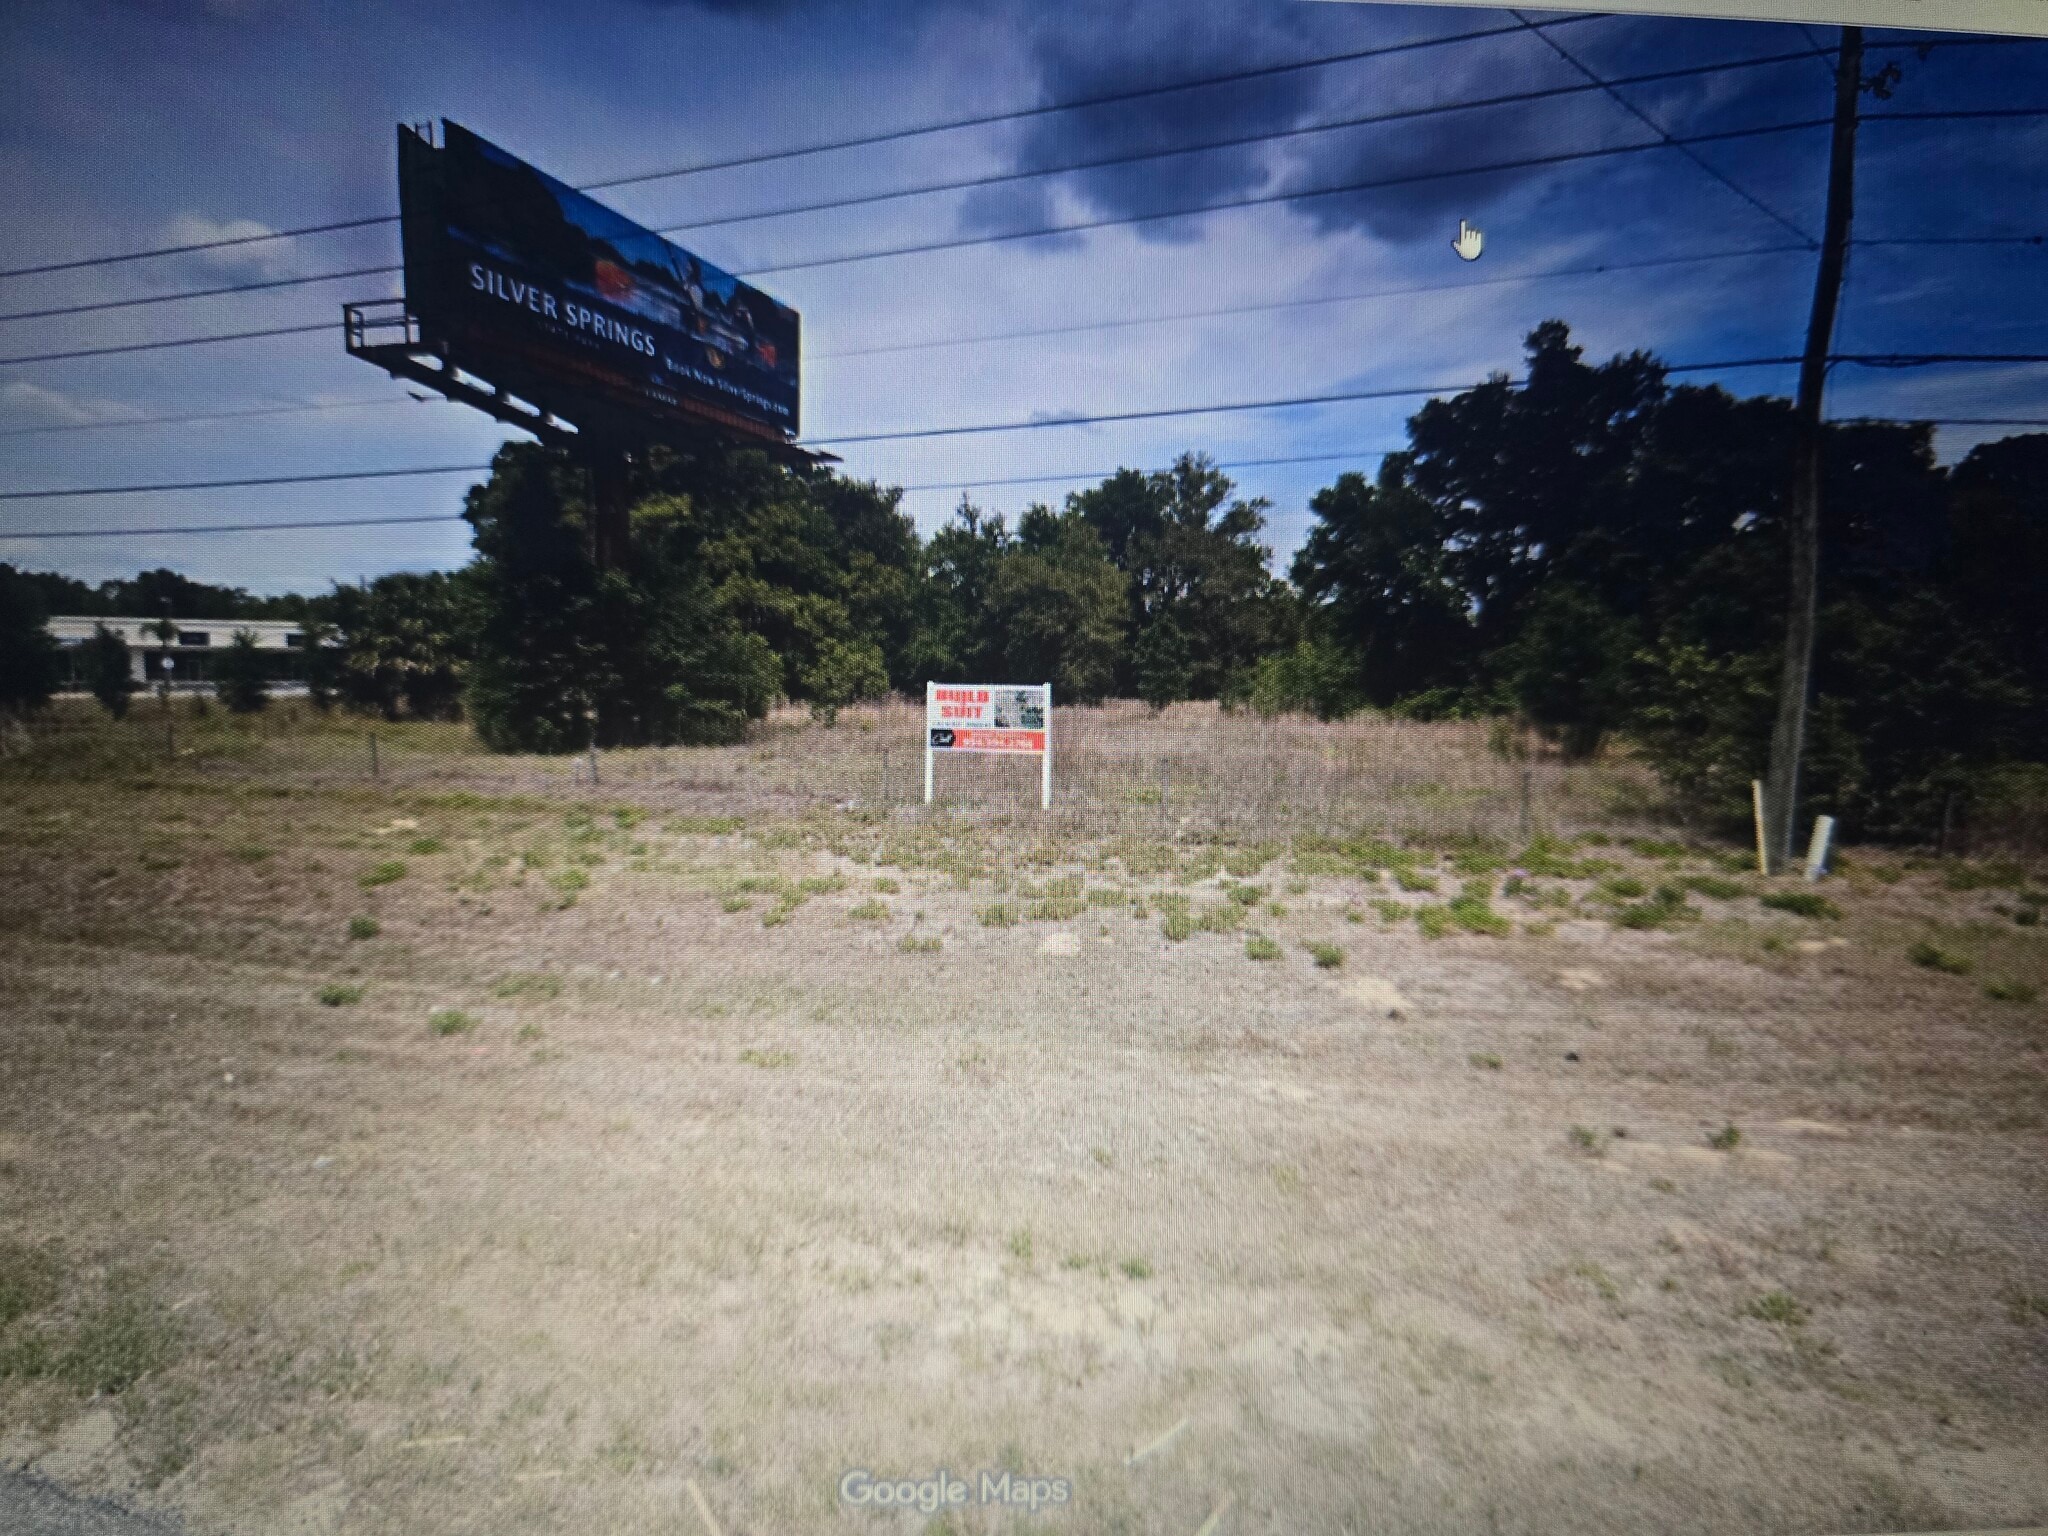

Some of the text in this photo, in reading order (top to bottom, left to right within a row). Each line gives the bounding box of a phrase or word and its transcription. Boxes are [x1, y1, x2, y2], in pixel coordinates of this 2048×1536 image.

[470, 264, 558, 320] SILVER
[565, 303, 656, 357] SPRINGS
[937, 690, 989, 702] BUILD
[942, 706, 982, 718] SUIT
